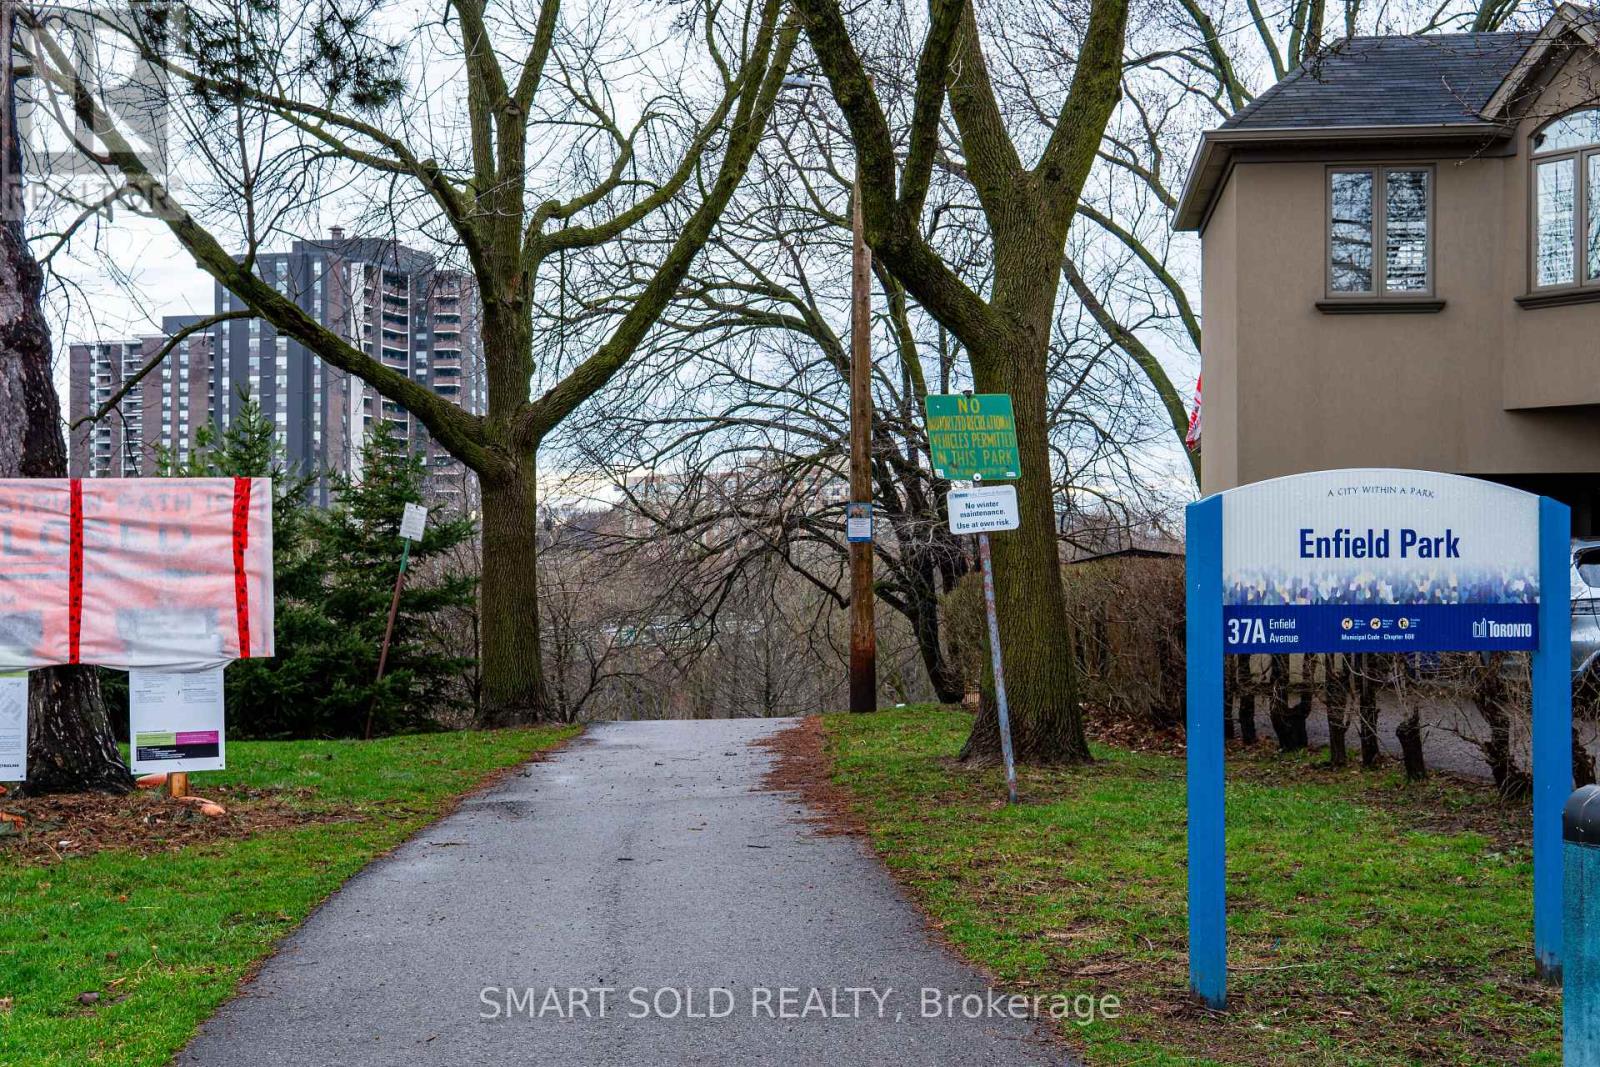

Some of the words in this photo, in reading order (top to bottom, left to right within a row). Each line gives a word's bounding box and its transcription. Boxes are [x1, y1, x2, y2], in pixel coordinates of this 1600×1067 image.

[957, 398, 980, 413] NO
[933, 432, 969, 449] VEHICLES
[971, 431, 1016, 448] PERMITTED
[951, 449, 977, 466] THIS
[982, 449, 1013, 465] PARK
[1327, 489, 1334, 497] A
[1337, 487, 1358, 496] CITY
[1361, 486, 1397, 494] WITHIN
[1410, 487, 1435, 499] PARK
[960, 509, 1006, 518] maintenance.
[956, 522, 970, 530] Use
[1299, 528, 1390, 559] Enfield
[1400, 528, 1460, 559] Park
[1269, 618, 1296, 629] Enfield
[1227, 618, 1266, 645] 37A
[1269, 632, 1299, 643] Avenue
[1341, 633, 1367, 641] Municipal
[1383, 633, 1404, 641] Chapter
